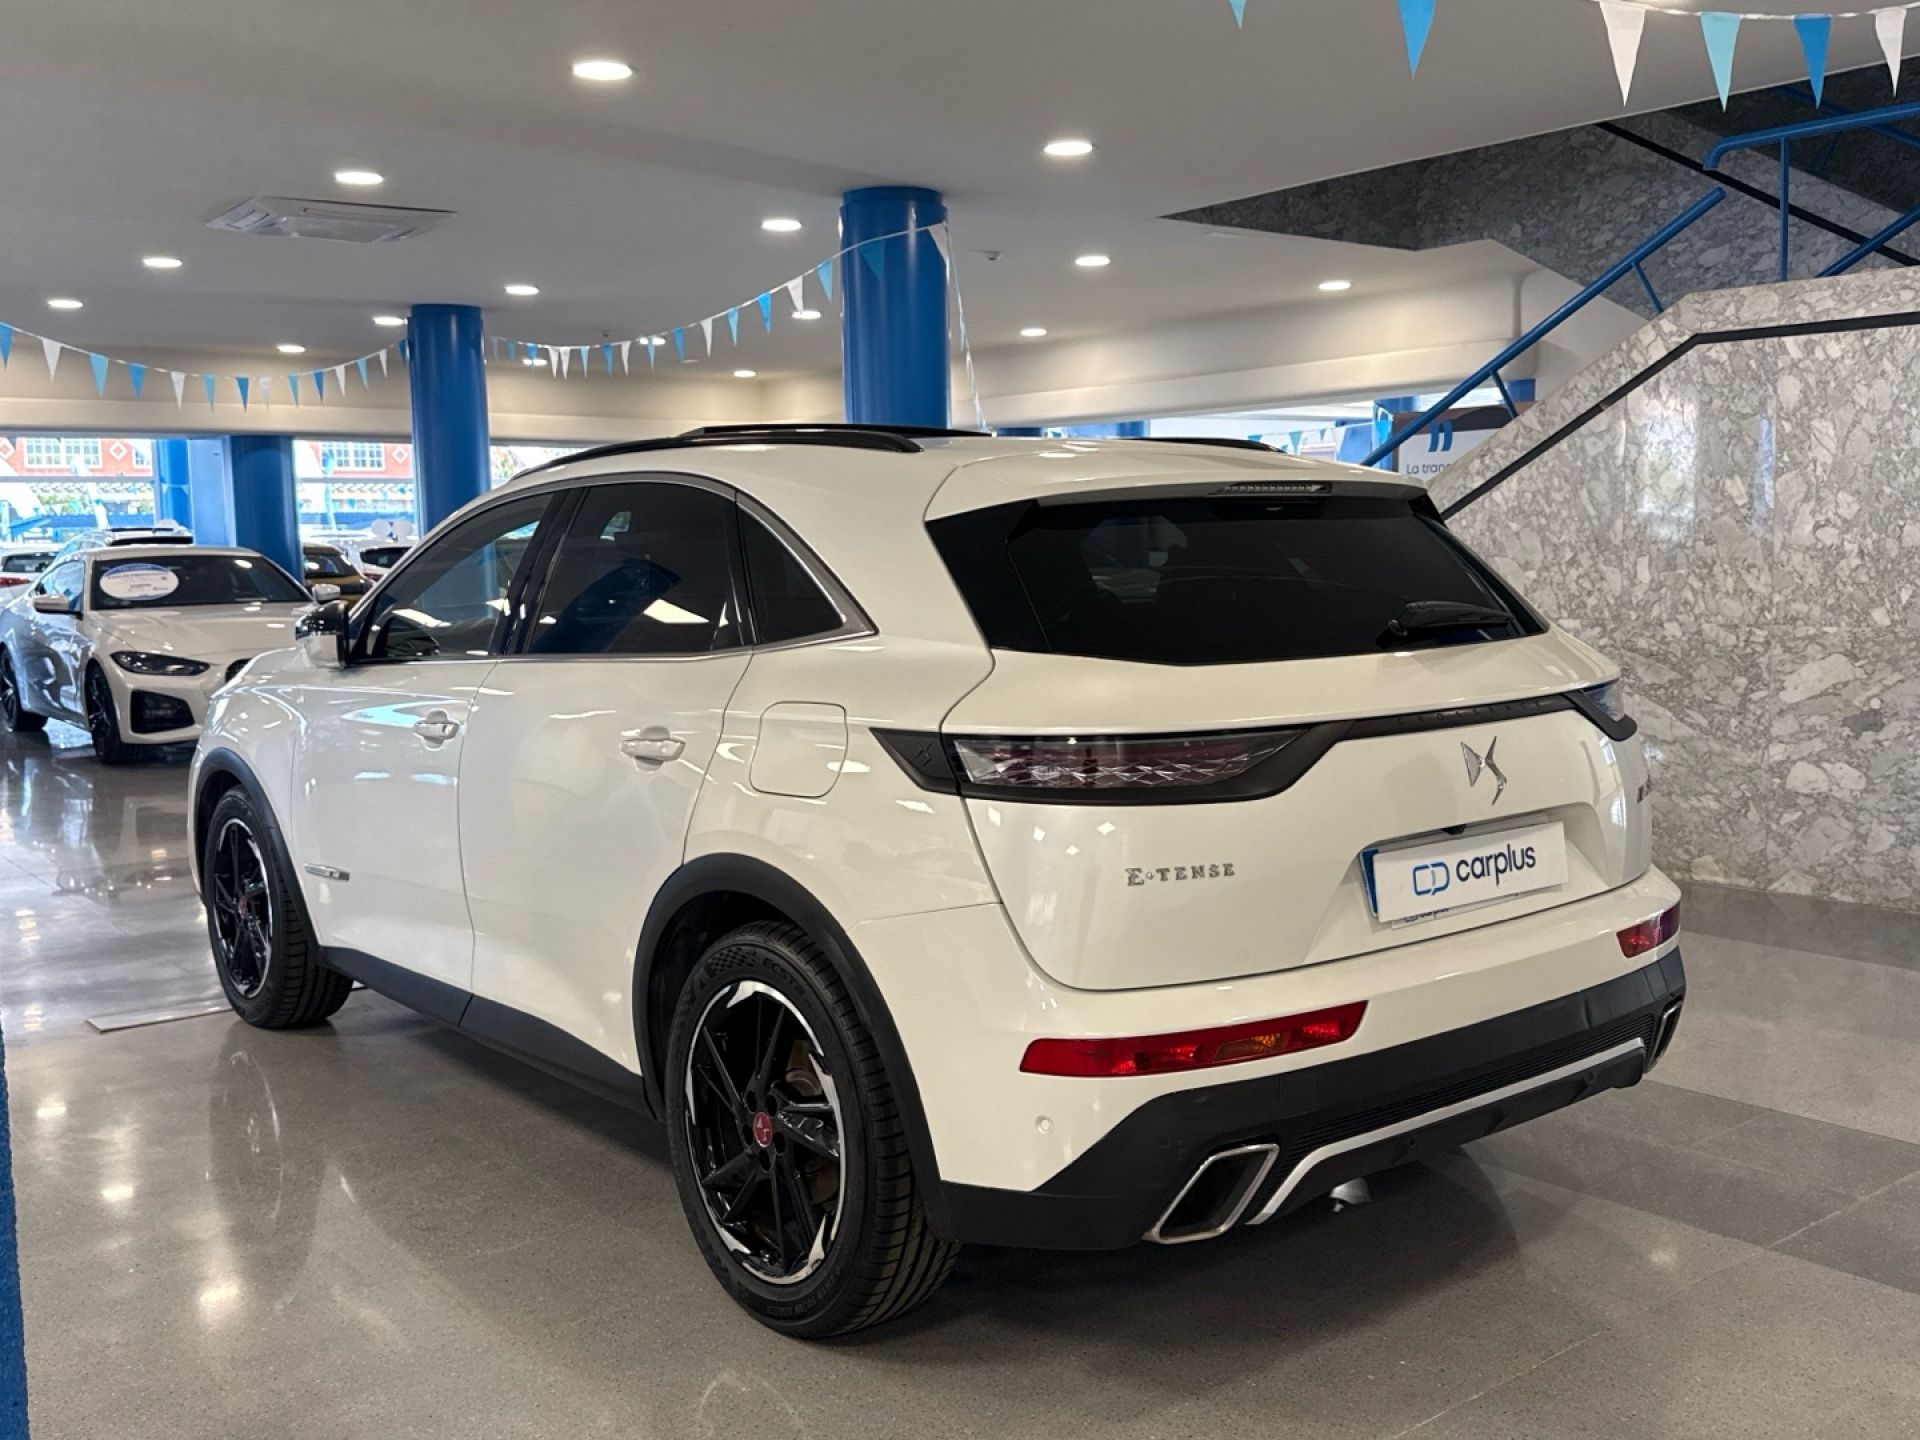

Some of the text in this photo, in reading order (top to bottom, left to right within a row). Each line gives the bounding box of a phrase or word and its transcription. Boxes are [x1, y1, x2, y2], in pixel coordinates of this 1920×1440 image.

[1406, 463, 1452, 474] La tran
[1455, 843, 1537, 887] carplus
